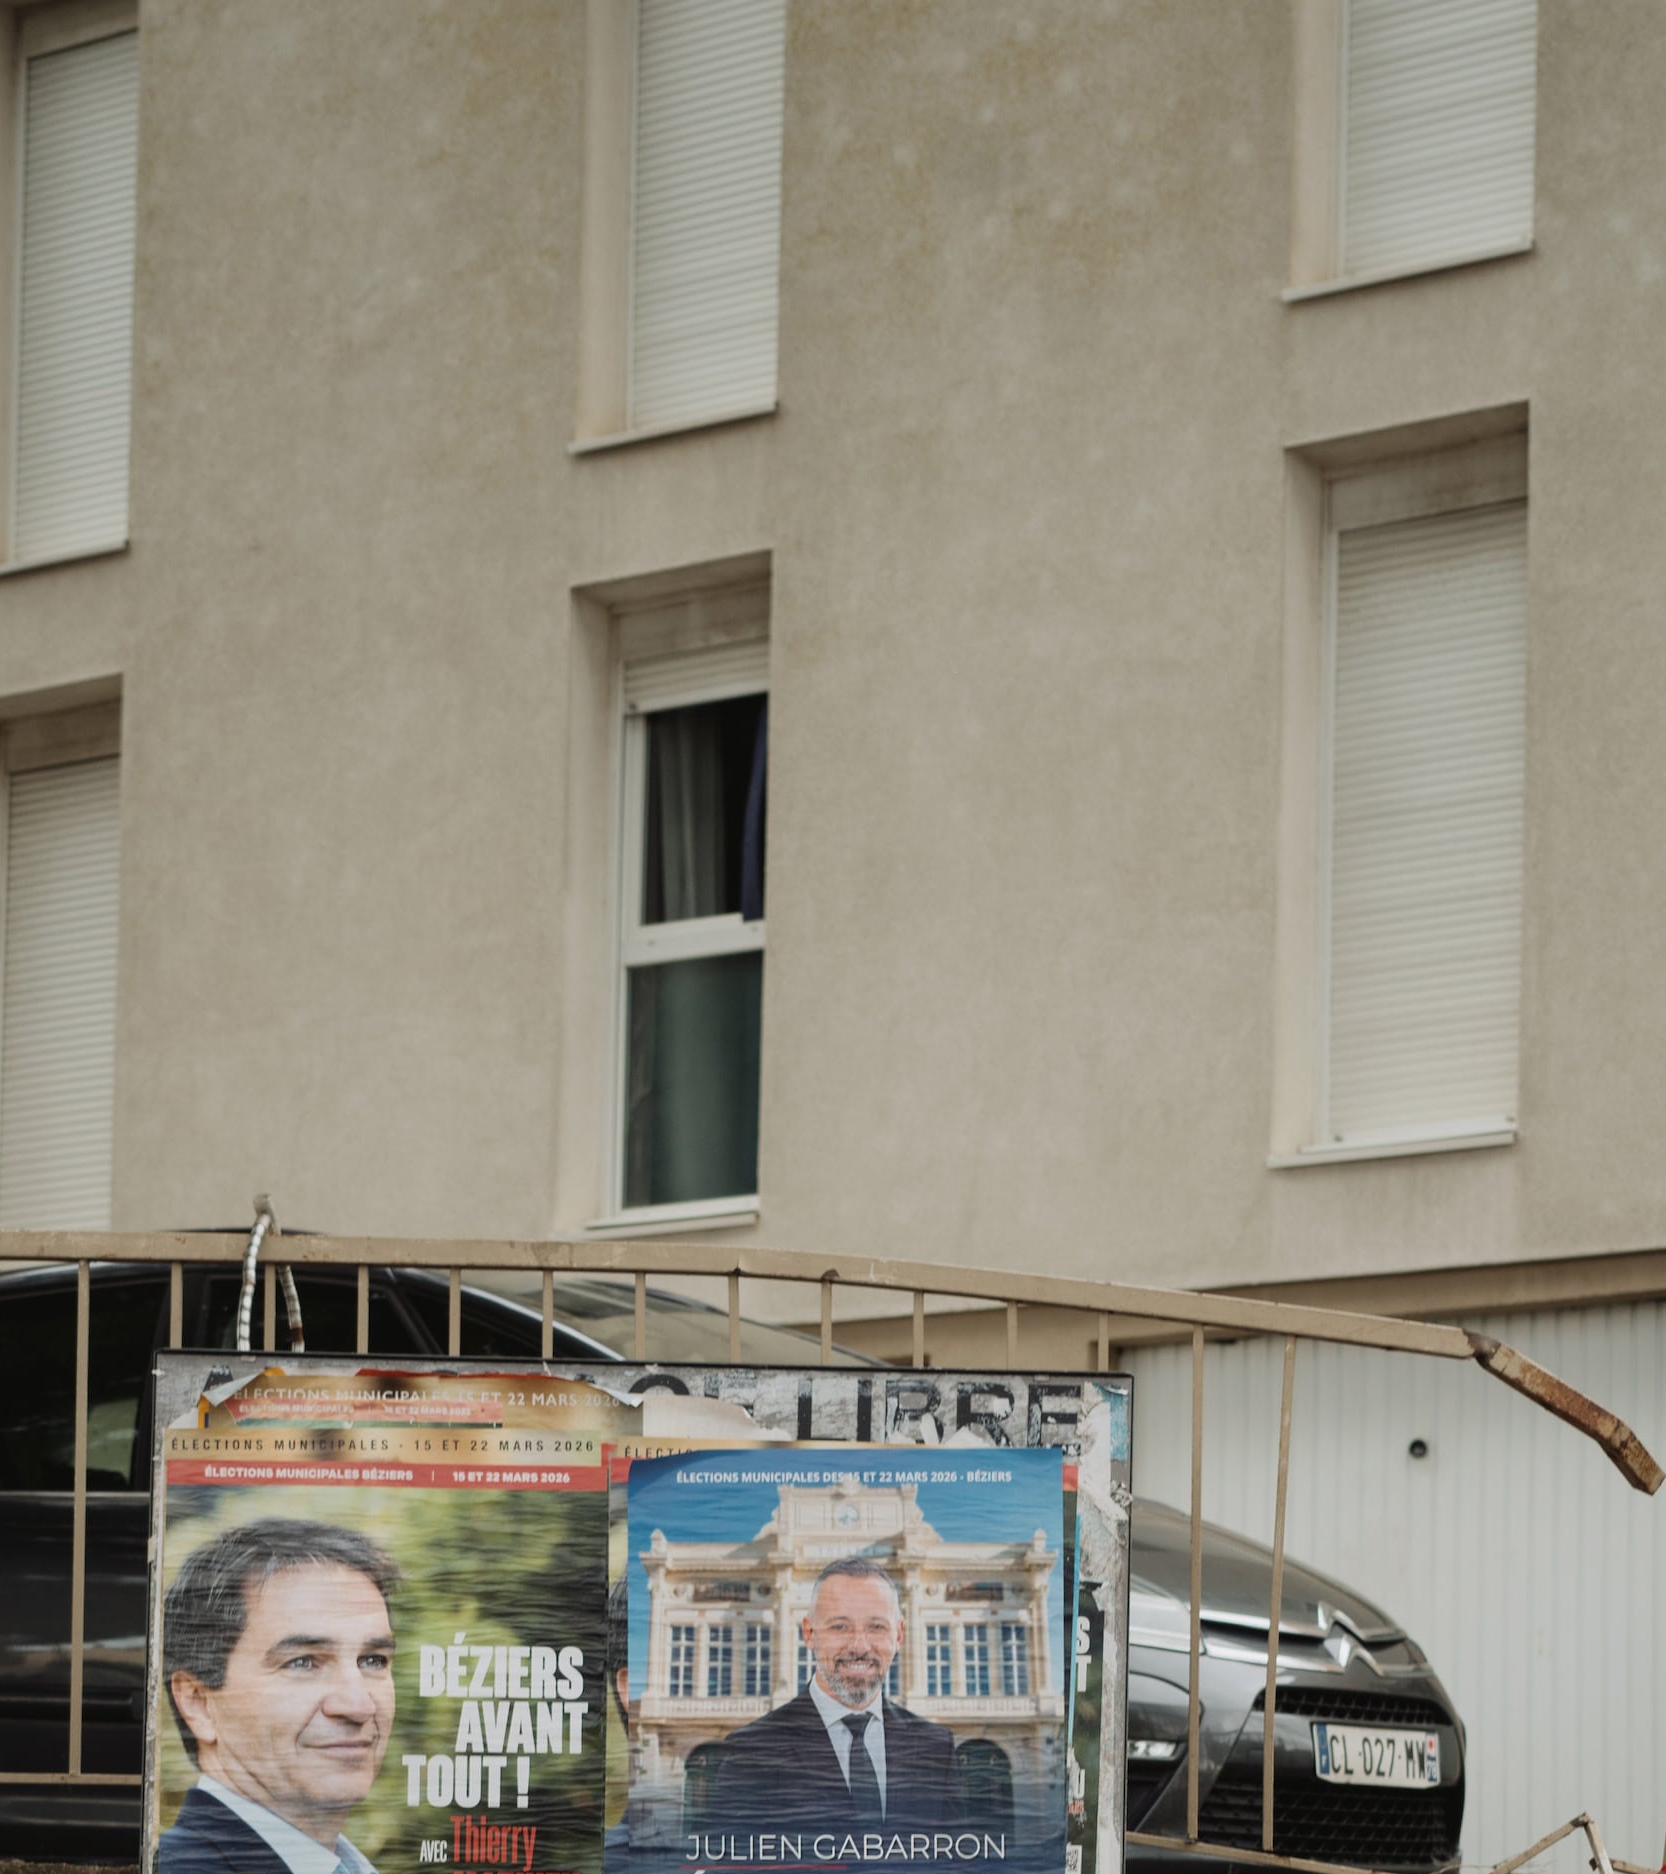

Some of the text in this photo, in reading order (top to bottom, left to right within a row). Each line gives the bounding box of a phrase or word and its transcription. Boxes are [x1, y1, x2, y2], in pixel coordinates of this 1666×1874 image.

[508, 1392, 526, 1406] 22
[531, 1392, 578, 1407] MARS
[171, 1437, 594, 1452] ÉLECTIONS MUNICIPALES 15 ET 22 MARS 2026
[205, 1464, 570, 1484] ÉLECTIONS MUNICIPALES BÉZIERS 15 ET 22 MARS 2026
[676, 1470, 739, 1484] ÉLECTIONS
[741, 1471, 820, 1484] MUNICIPALES
[823, 1471, 844, 1483] DES
[863, 1471, 876, 1483] ET
[879, 1471, 892, 1483] 22
[895, 1471, 928, 1483] MARS
[931, 1472, 957, 1483] 2026
[967, 1468, 1013, 1483] BÉZIERS
[419, 1631, 584, 1700] BÉZIERS
[454, 1700, 589, 1754] AVANT
[401, 1754, 508, 1808] TOUT
[419, 1814, 537, 1872] AVEC Thierry
[685, 1832, 1006, 1861] JULIEN GABARRON
